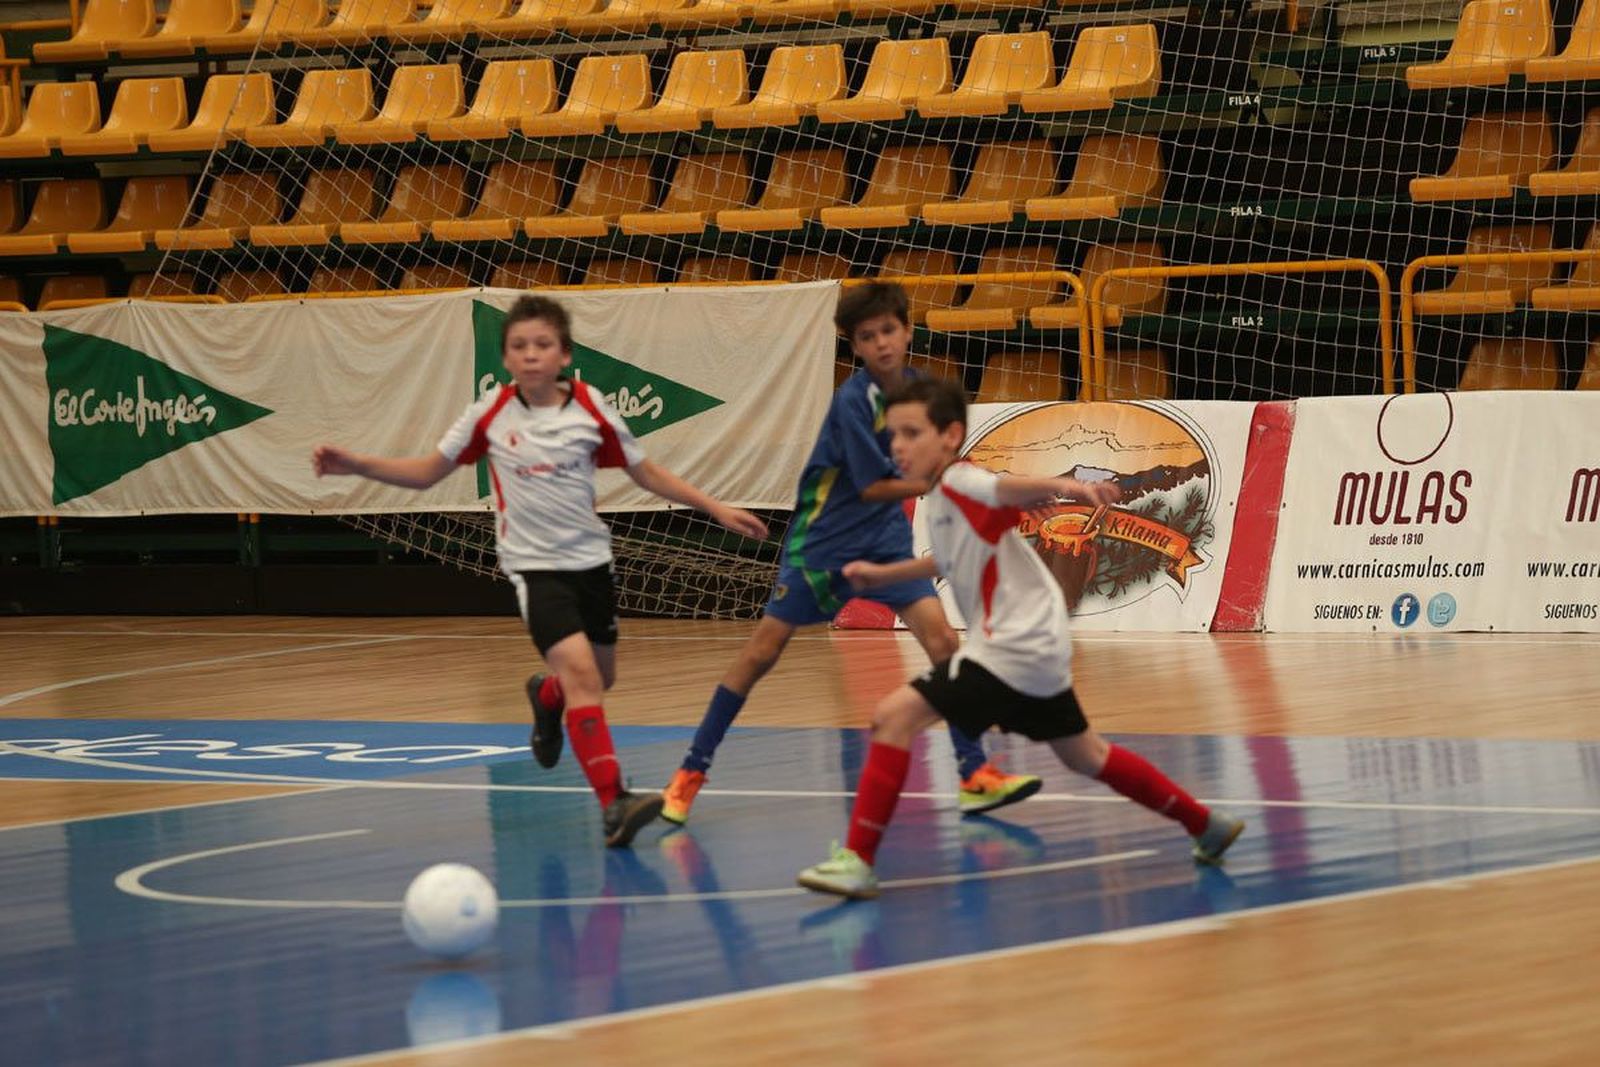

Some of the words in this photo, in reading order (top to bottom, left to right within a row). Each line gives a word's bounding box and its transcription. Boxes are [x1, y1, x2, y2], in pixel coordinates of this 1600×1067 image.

[1364, 47, 1387, 58] FILA
[1389, 47, 1396, 57] 5
[1229, 95, 1251, 106] FILA
[1253, 95, 1260, 105] 4
[1231, 206, 1254, 217] FILA
[1255, 205, 1262, 216] 3
[1232, 316, 1255, 326] FILA
[1256, 316, 1264, 326] 2
[1333, 470, 1473, 526] MULAS
[1107, 515, 1172, 550] Kilama
[1368, 533, 1398, 546] desde
[1402, 533, 1424, 546] 1810
[1297, 555, 1486, 580] www.carnicasmulas.com
[1313, 604, 1364, 620] SIGUENOS
[1366, 604, 1384, 620] EN:
[1544, 604, 1598, 620] SIGUENOS
